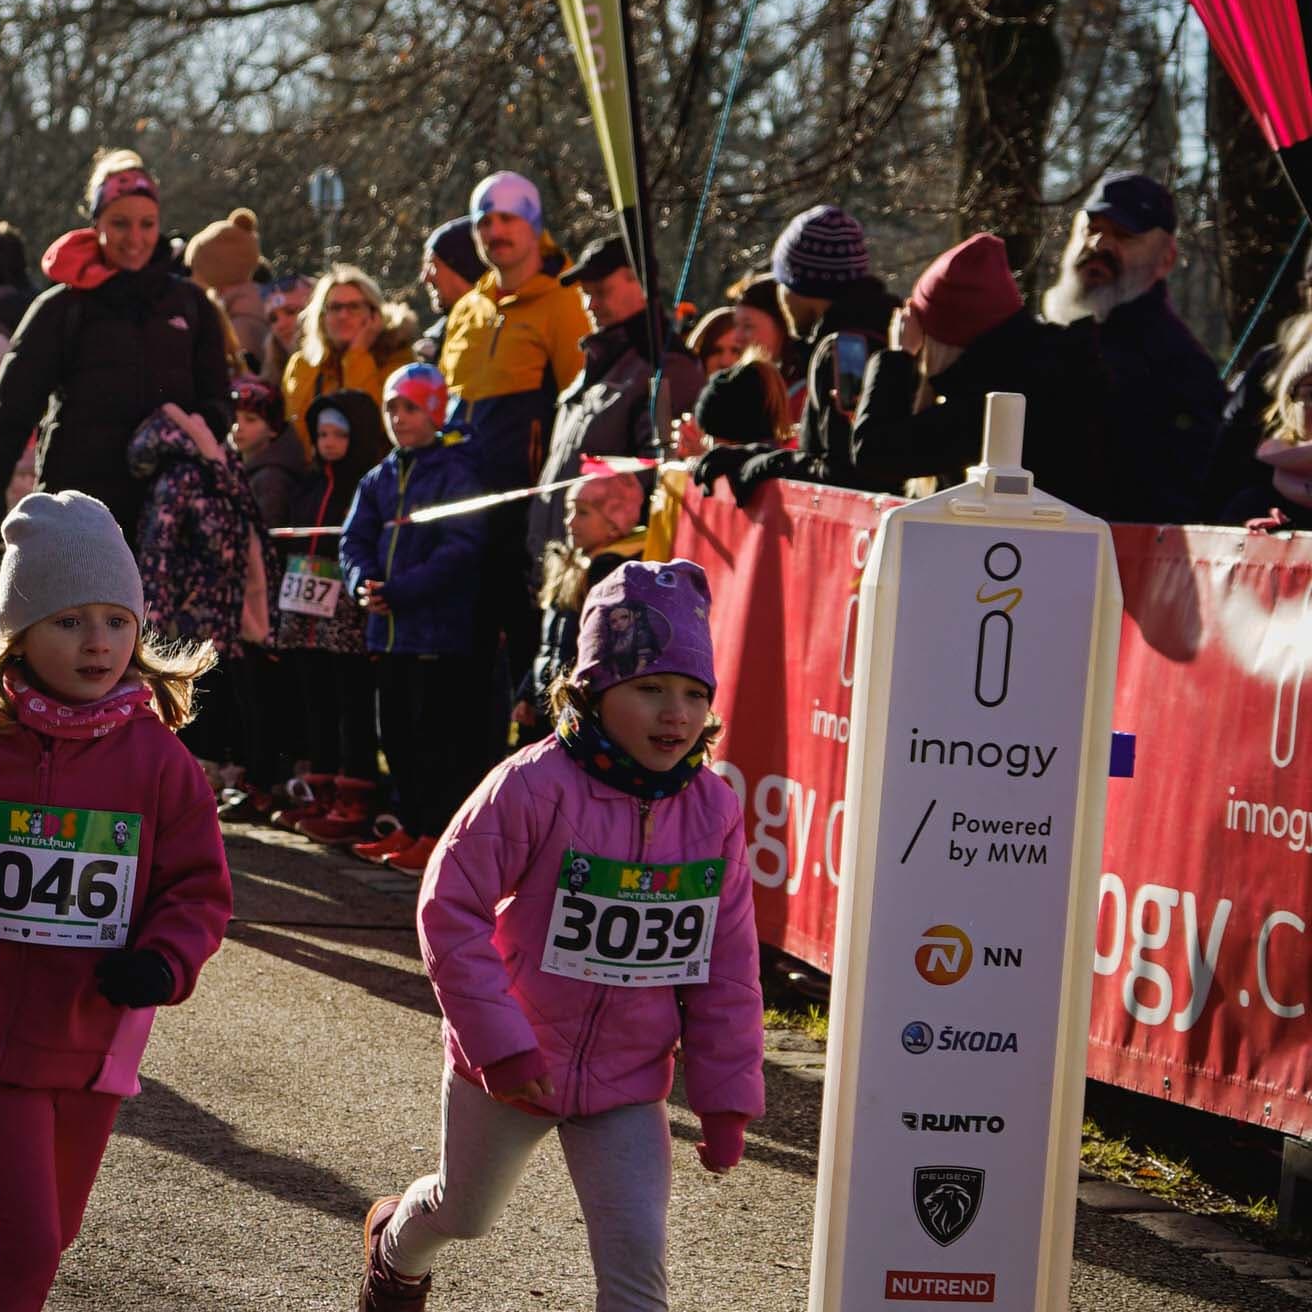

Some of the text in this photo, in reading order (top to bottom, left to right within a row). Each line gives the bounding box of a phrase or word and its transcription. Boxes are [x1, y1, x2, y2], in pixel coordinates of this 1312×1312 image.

[909, 727, 1058, 778] innogy
[950, 812, 1052, 837] Powered
[1226, 785, 1312, 853] innog
[948, 839, 1048, 868] by MVM
[553, 895, 705, 961] 3039
[982, 946, 1023, 968] NN
[937, 1025, 1019, 1054] ŠKODA
[921, 1113, 1005, 1134] RUNTO
[921, 1172, 978, 1183] PEUGEOT
[892, 1277, 990, 1297] NUTREND
